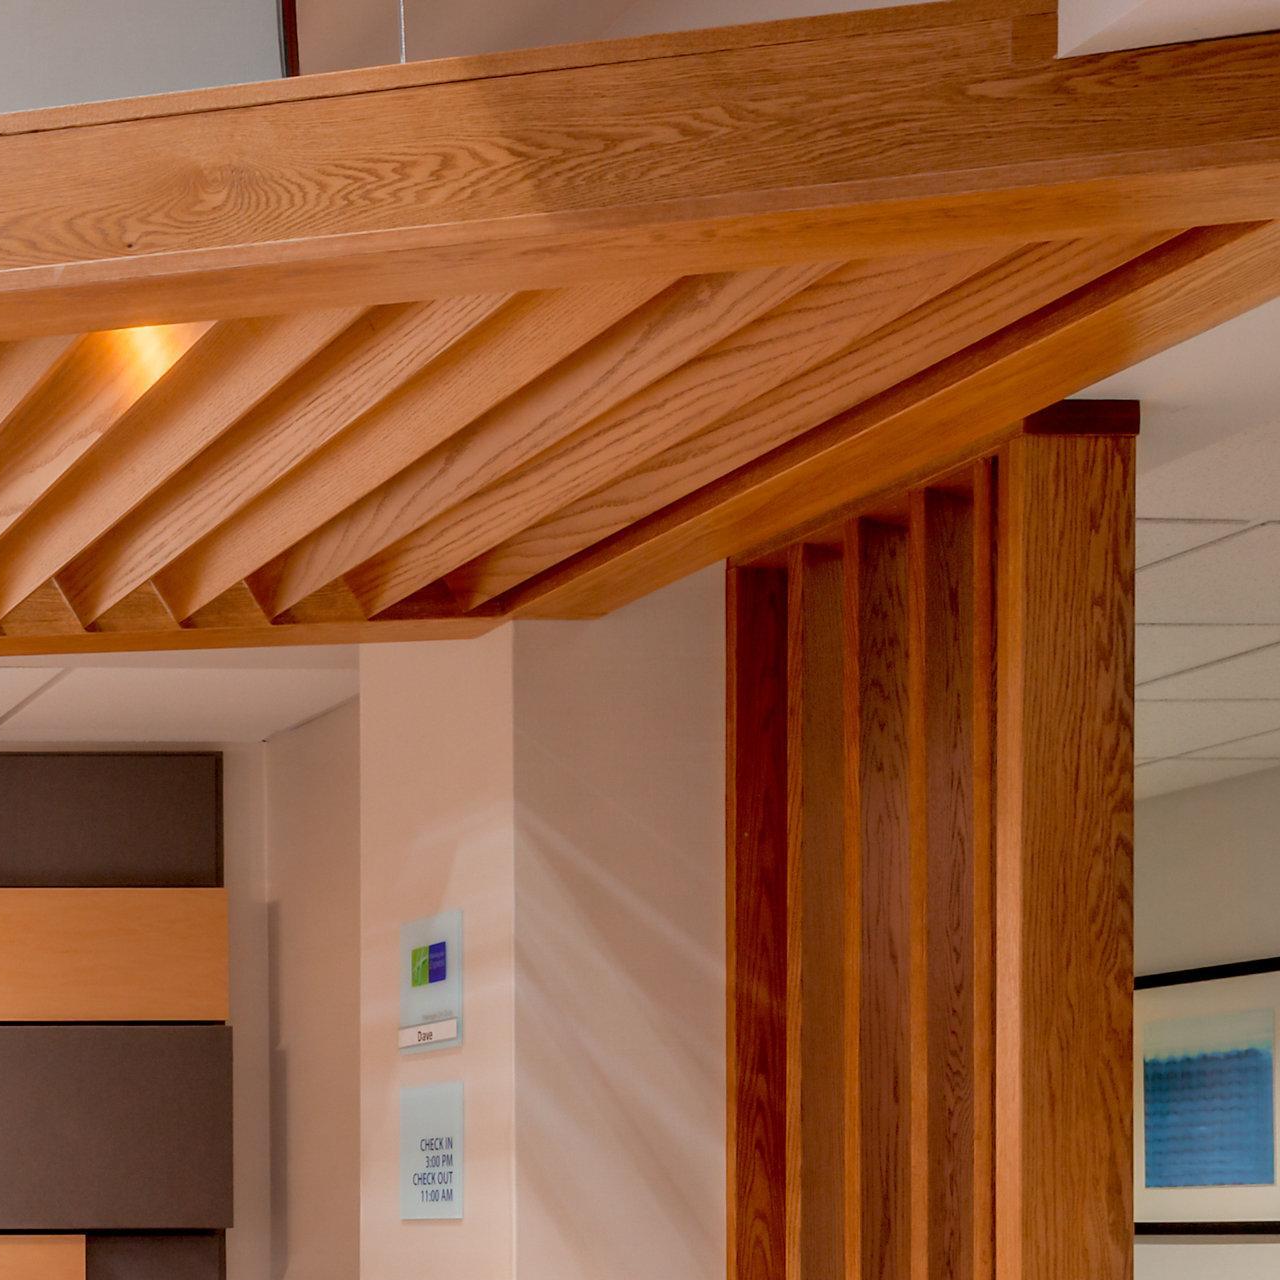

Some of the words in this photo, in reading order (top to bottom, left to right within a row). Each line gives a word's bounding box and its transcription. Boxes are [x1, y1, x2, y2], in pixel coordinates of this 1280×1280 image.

[417, 1030, 433, 1042] Dave
[419, 1137, 444, 1152] CHECK
[445, 1136, 453, 1150] IN
[425, 1155, 440, 1168] 3:00
[441, 1154, 453, 1167] PM
[412, 1172, 436, 1186] CHECK
[437, 1171, 453, 1185] OUT
[421, 1189, 440, 1202] 11:00
[441, 1188, 453, 1202] AM
